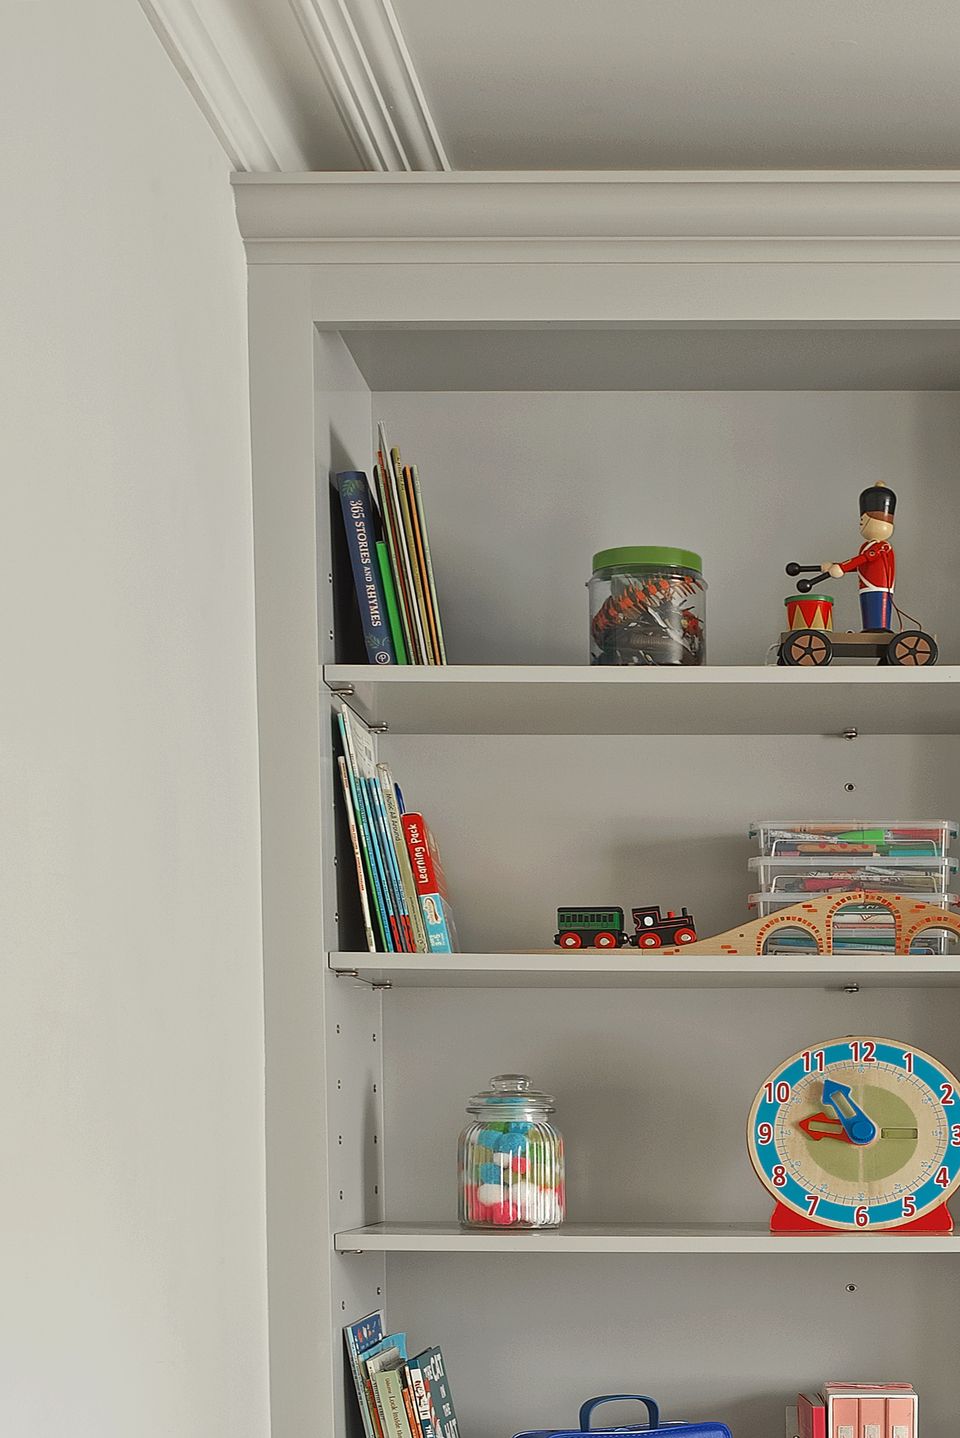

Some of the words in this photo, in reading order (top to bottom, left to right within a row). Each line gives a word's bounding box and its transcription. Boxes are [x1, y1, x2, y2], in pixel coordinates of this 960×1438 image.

[349, 499, 365, 520] 365
[354, 520, 372, 564] STORIES
[363, 565, 373, 582] AND
[364, 583, 383, 627] RHYMES
[406, 823, 422, 845] Pack
[410, 845, 433, 884] Learning
[802, 1051, 824, 1072] 11
[850, 1041, 876, 1062] 12
[904, 1052, 913, 1073] 1
[764, 1082, 790, 1103] 10
[941, 1084, 954, 1104] 2
[759, 1124, 772, 1144] 9
[772, 1165, 786, 1186] 8
[935, 1167, 949, 1188] 4
[806, 1195, 819, 1216] 7
[903, 1196, 916, 1217] 5
[855, 1206, 868, 1227] 6
[430, 1353, 444, 1382] CAT
[388, 1395, 398, 1411] Look
[392, 1411, 403, 1429] inside
[396, 1429, 404, 1438] the
[424, 1425, 433, 1438] THE
